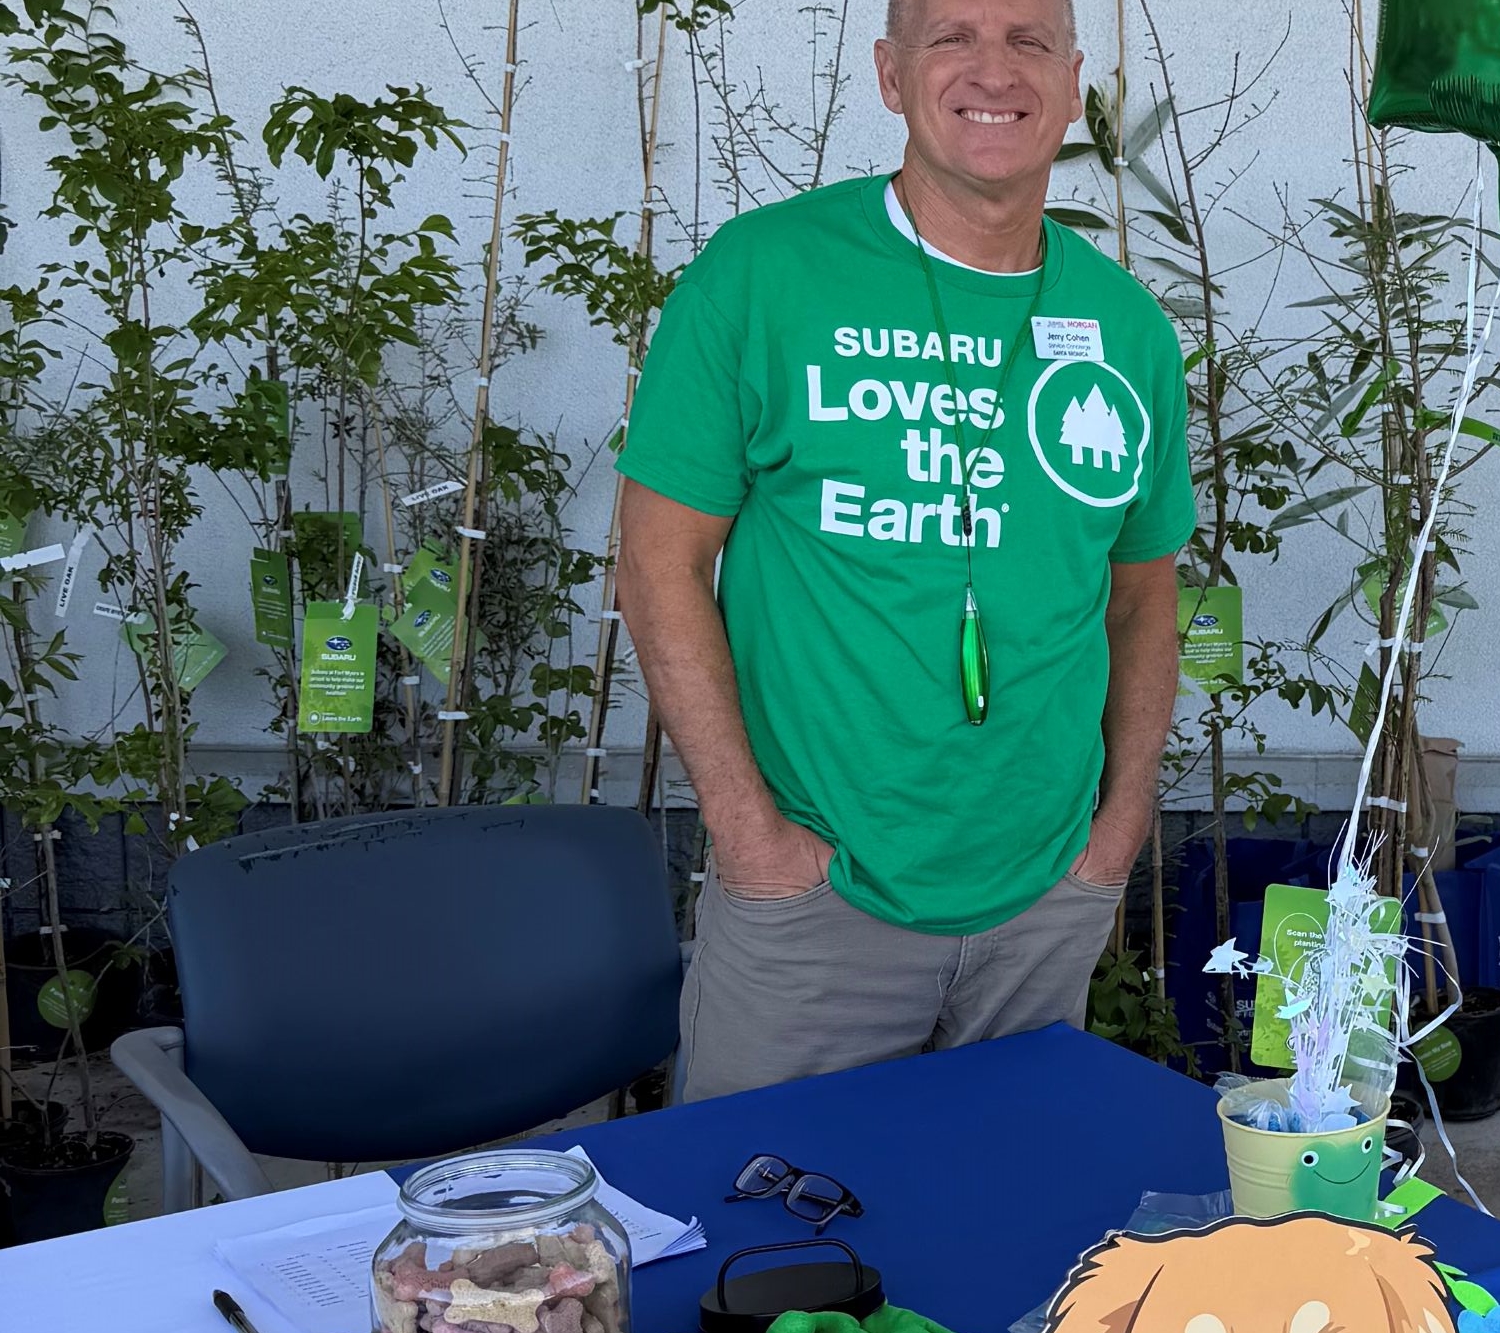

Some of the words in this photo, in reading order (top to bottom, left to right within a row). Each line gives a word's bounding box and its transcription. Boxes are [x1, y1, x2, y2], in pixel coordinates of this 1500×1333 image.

[834, 326, 1002, 367] SUBARU
[1066, 333, 1090, 342] Cohen
[806, 364, 1005, 430] Loves
[900, 427, 1005, 489] the
[59, 587, 69, 608] LIVE
[64, 566, 74, 585] OAK
[321, 653, 357, 661] SUBARU
[1286, 929, 1308, 937] Scan
[1309, 931, 1323, 939] the
